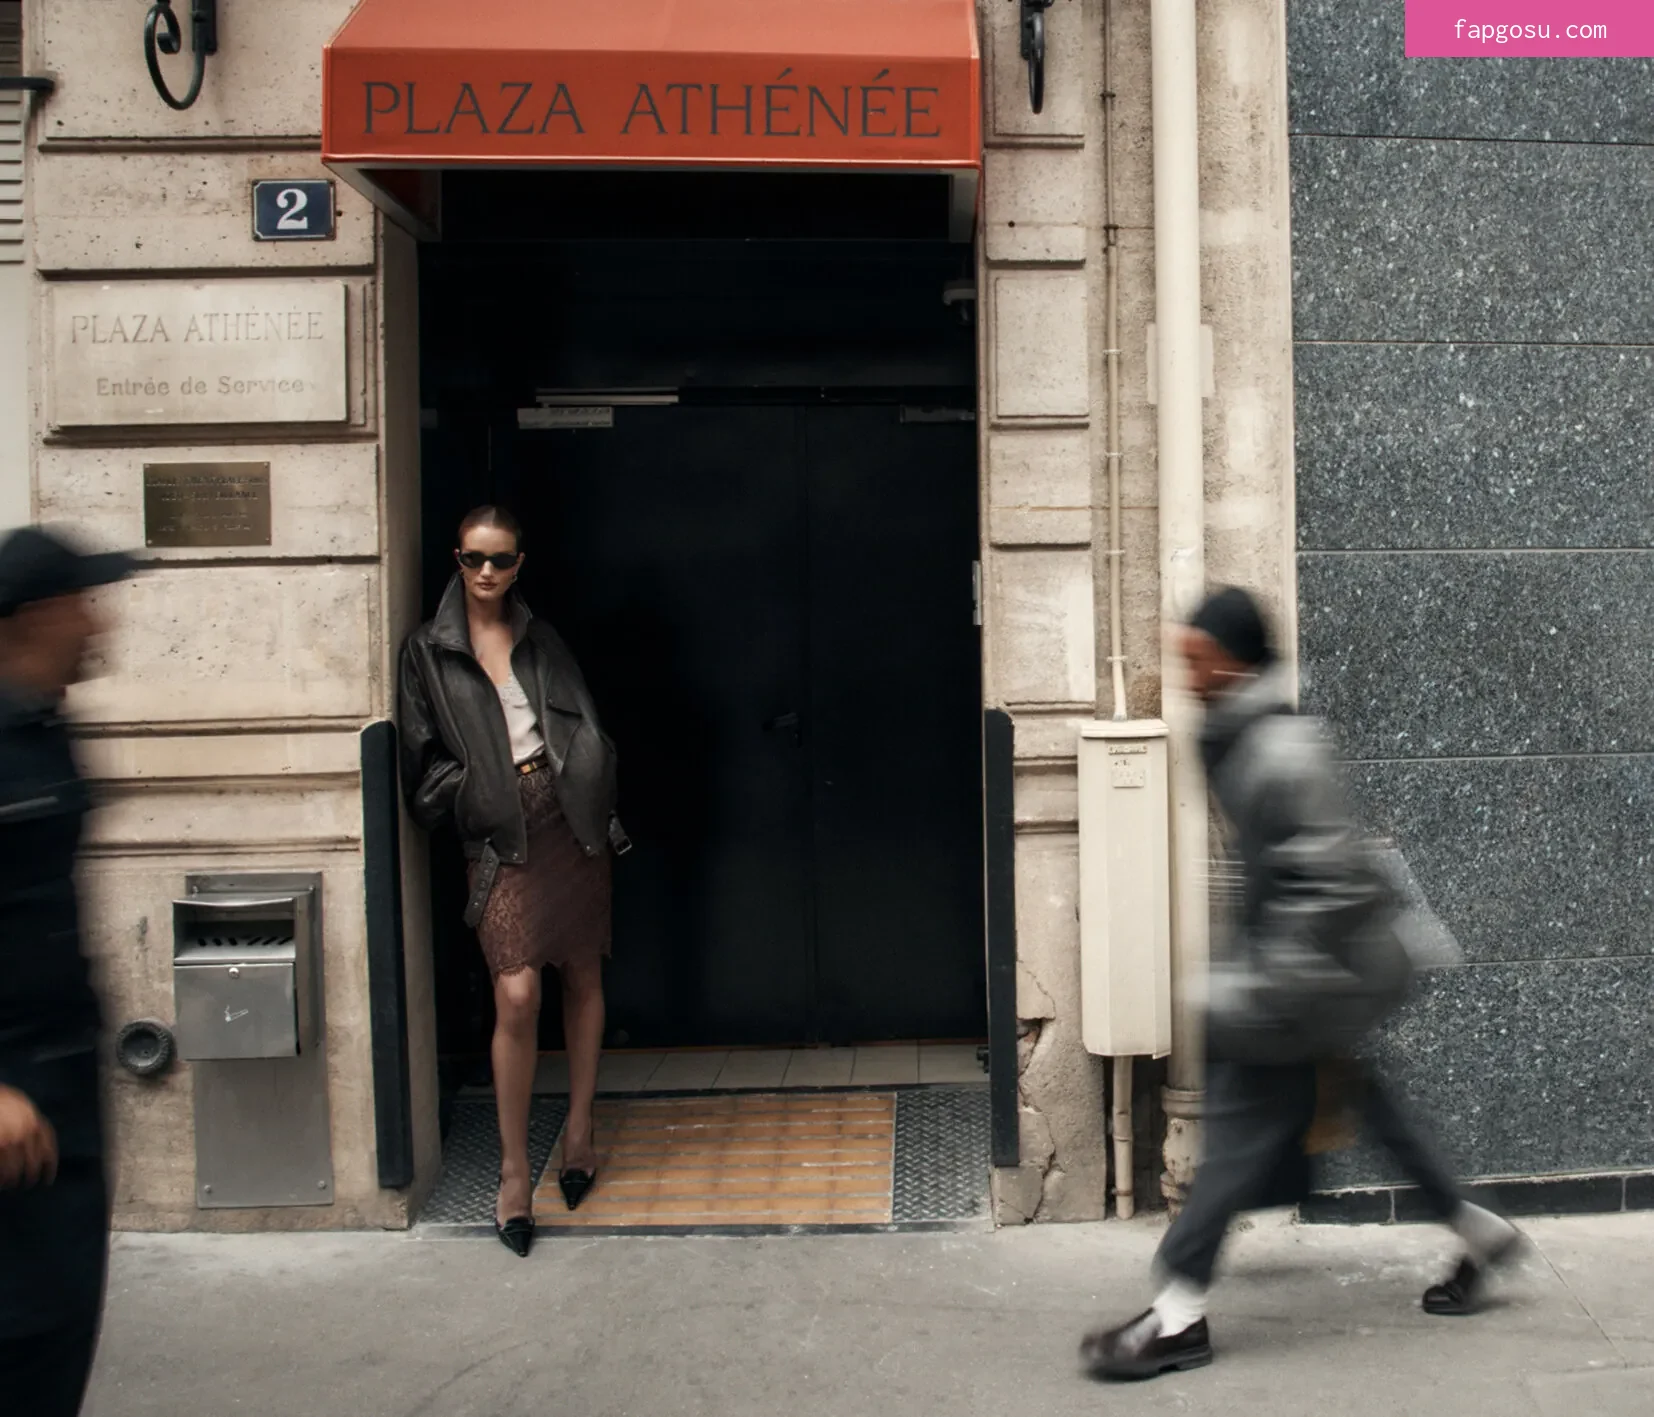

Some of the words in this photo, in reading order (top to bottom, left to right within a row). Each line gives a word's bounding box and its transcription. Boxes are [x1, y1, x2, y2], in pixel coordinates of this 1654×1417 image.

[362, 80, 586, 134] PLAZA
[620, 68, 941, 138] ATHÉNÉE
[276, 188, 308, 230] 2
[71, 314, 170, 344] PLAZA
[183, 305, 324, 343] ATHÉNÉE
[96, 376, 170, 396] Entrée
[180, 376, 207, 395] de
[217, 376, 304, 394] Service
